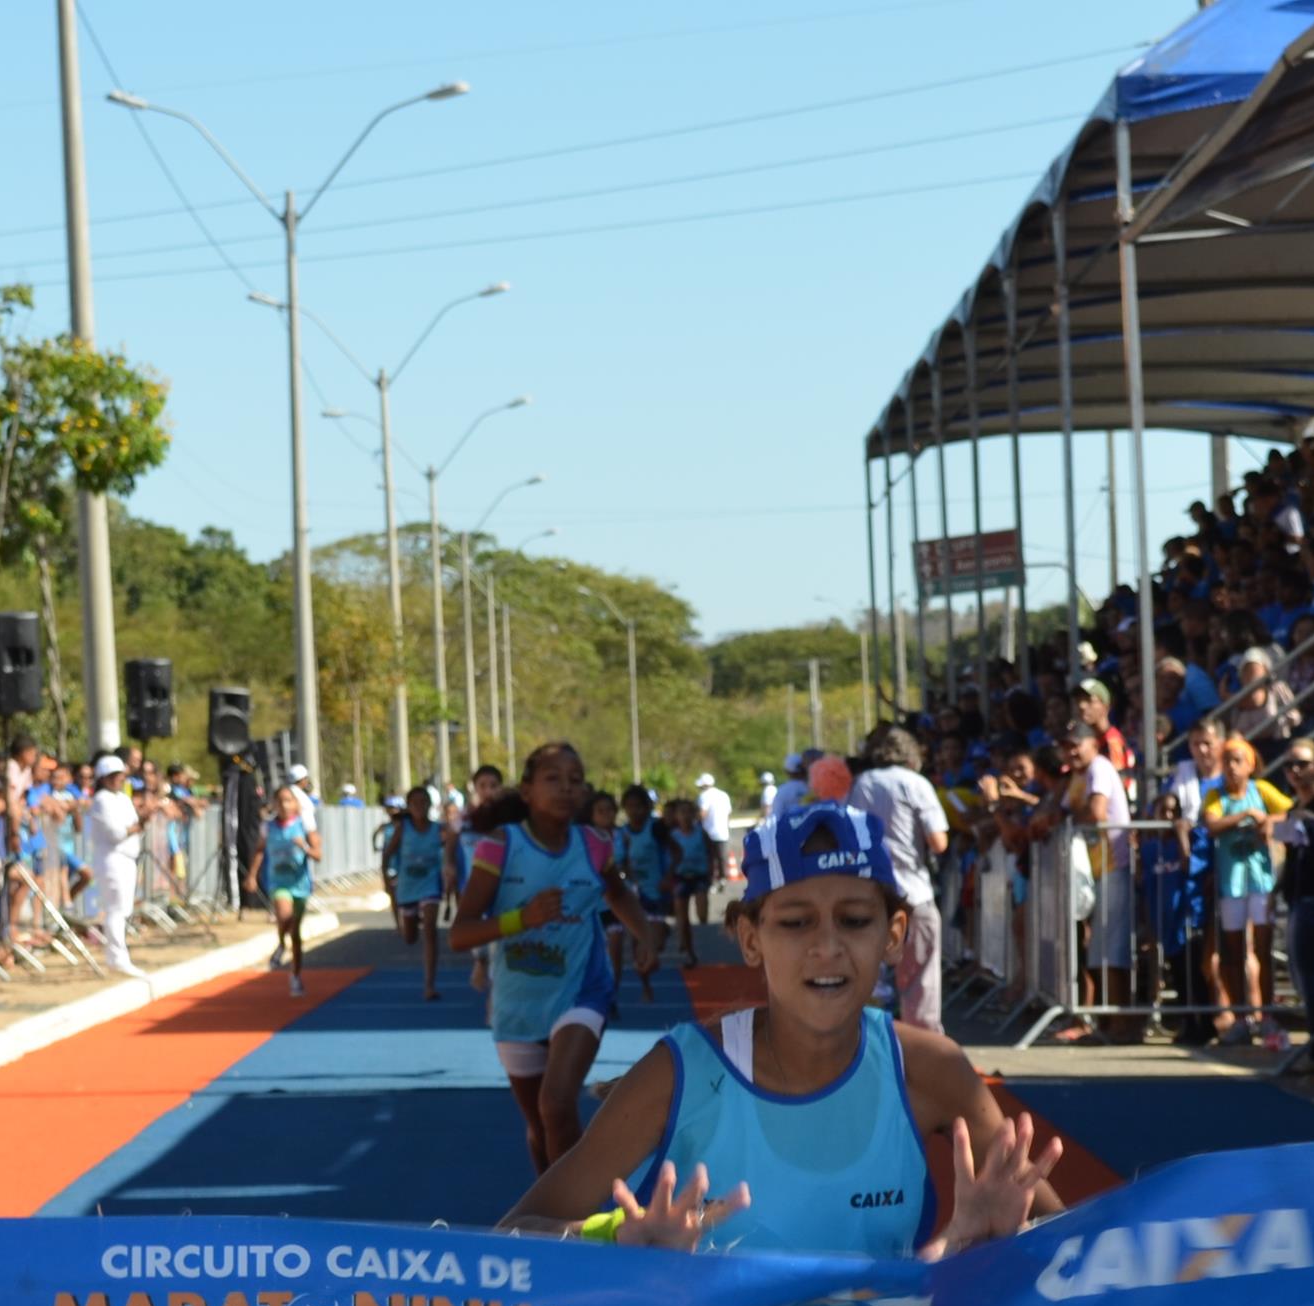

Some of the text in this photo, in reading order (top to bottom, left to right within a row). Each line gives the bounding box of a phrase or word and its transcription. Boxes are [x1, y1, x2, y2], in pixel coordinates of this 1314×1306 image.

[817, 851, 869, 870] CAIXA
[849, 1189, 906, 1209] CAIXA
[101, 1244, 533, 1292] CIRCUITO CAIXA DE
